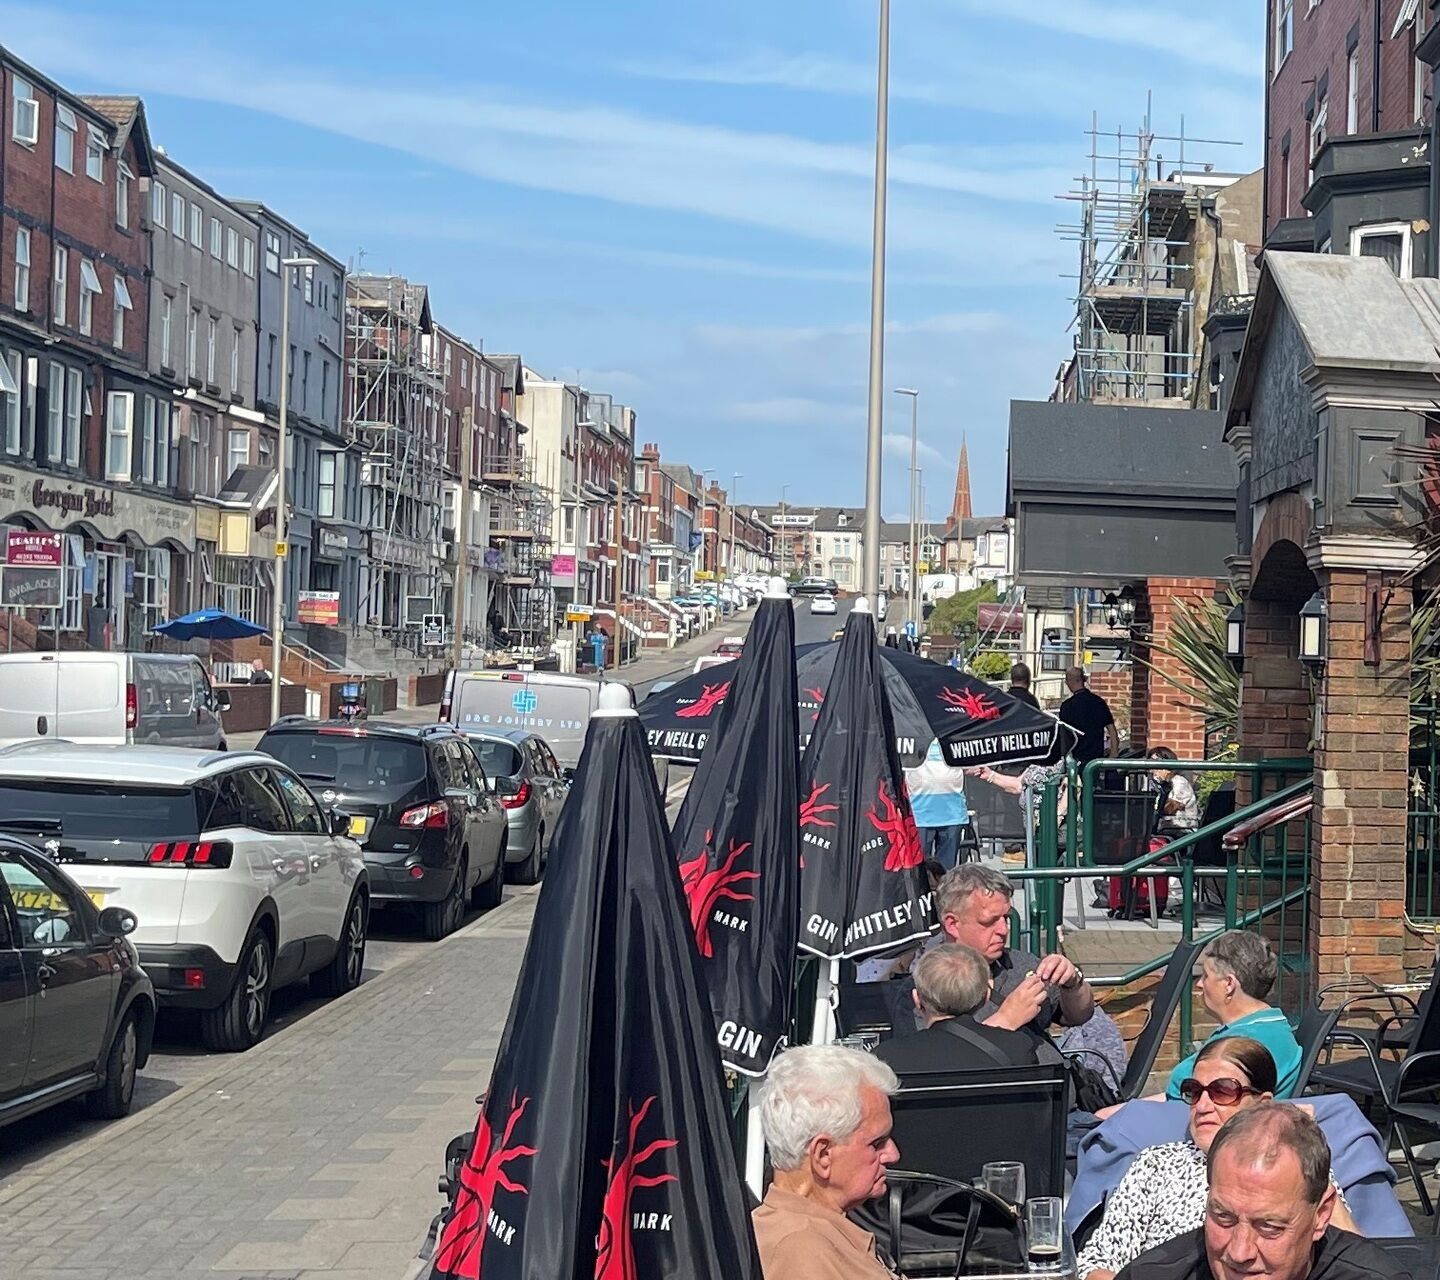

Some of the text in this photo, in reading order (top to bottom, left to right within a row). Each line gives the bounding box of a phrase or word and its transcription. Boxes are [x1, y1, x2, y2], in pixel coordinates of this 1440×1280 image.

[664, 731, 695, 749] NEILL
[897, 738, 914, 754] IN
[950, 731, 1051, 758] WHITLEY NEILL GIN
[803, 832, 831, 850] MARK
[714, 910, 749, 932] MARK
[807, 914, 838, 944] GIN
[717, 1020, 762, 1058] GIN
